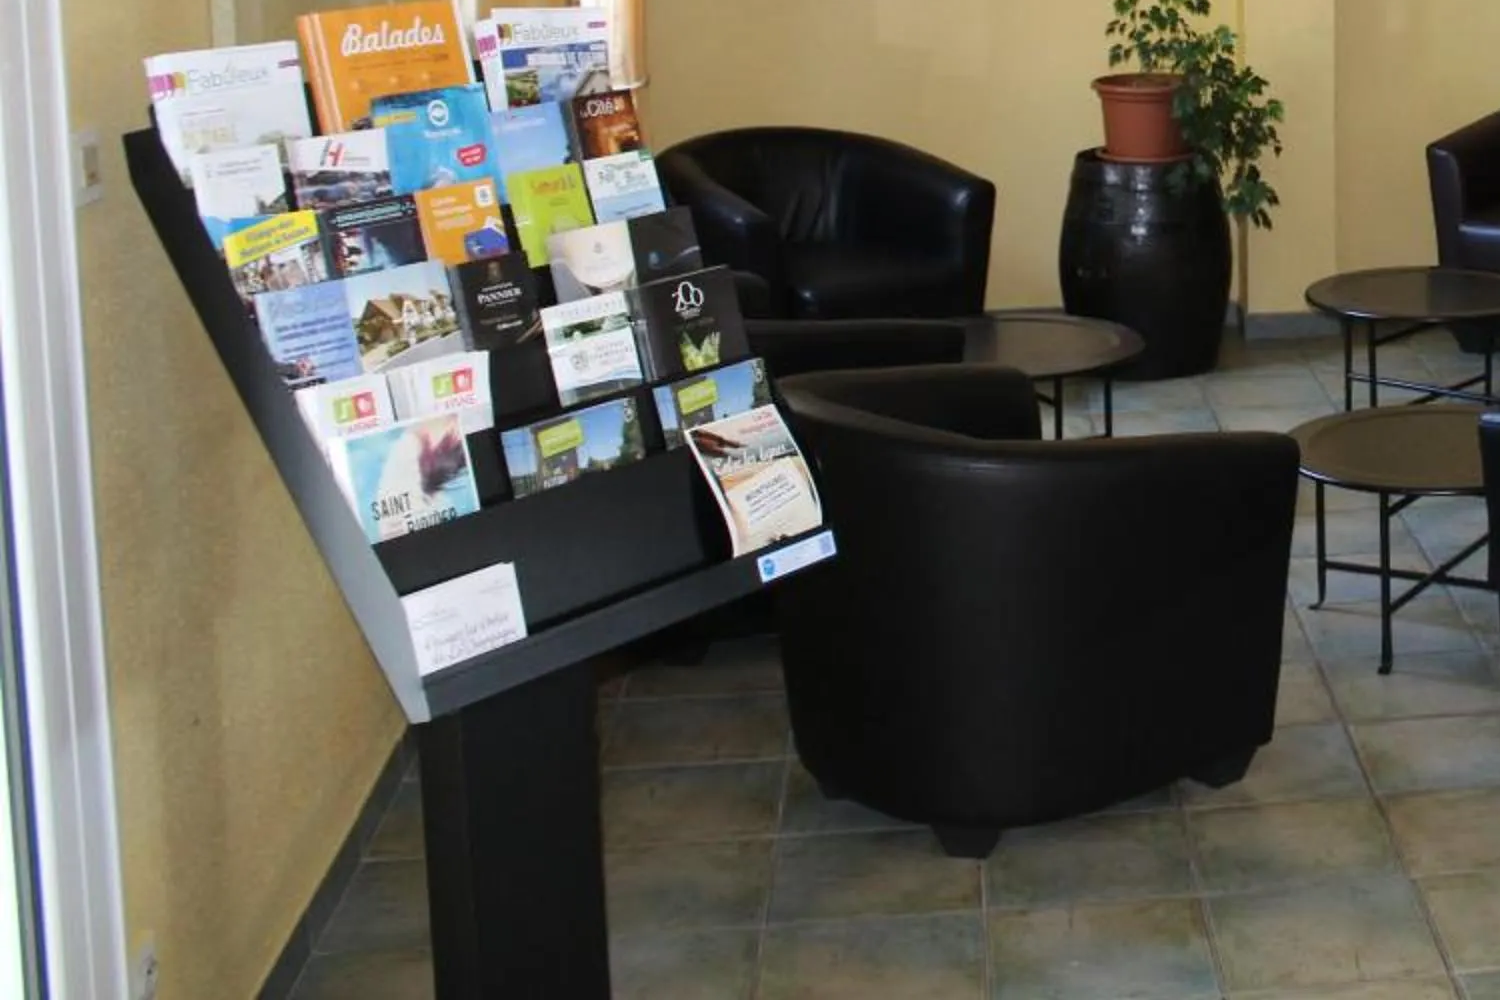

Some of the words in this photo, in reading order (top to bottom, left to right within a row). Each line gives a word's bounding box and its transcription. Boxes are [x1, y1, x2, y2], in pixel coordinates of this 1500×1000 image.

[341, 16, 446, 57] Balades
[477, 286, 523, 304] PANNIER
[371, 492, 412, 522] SAINT
